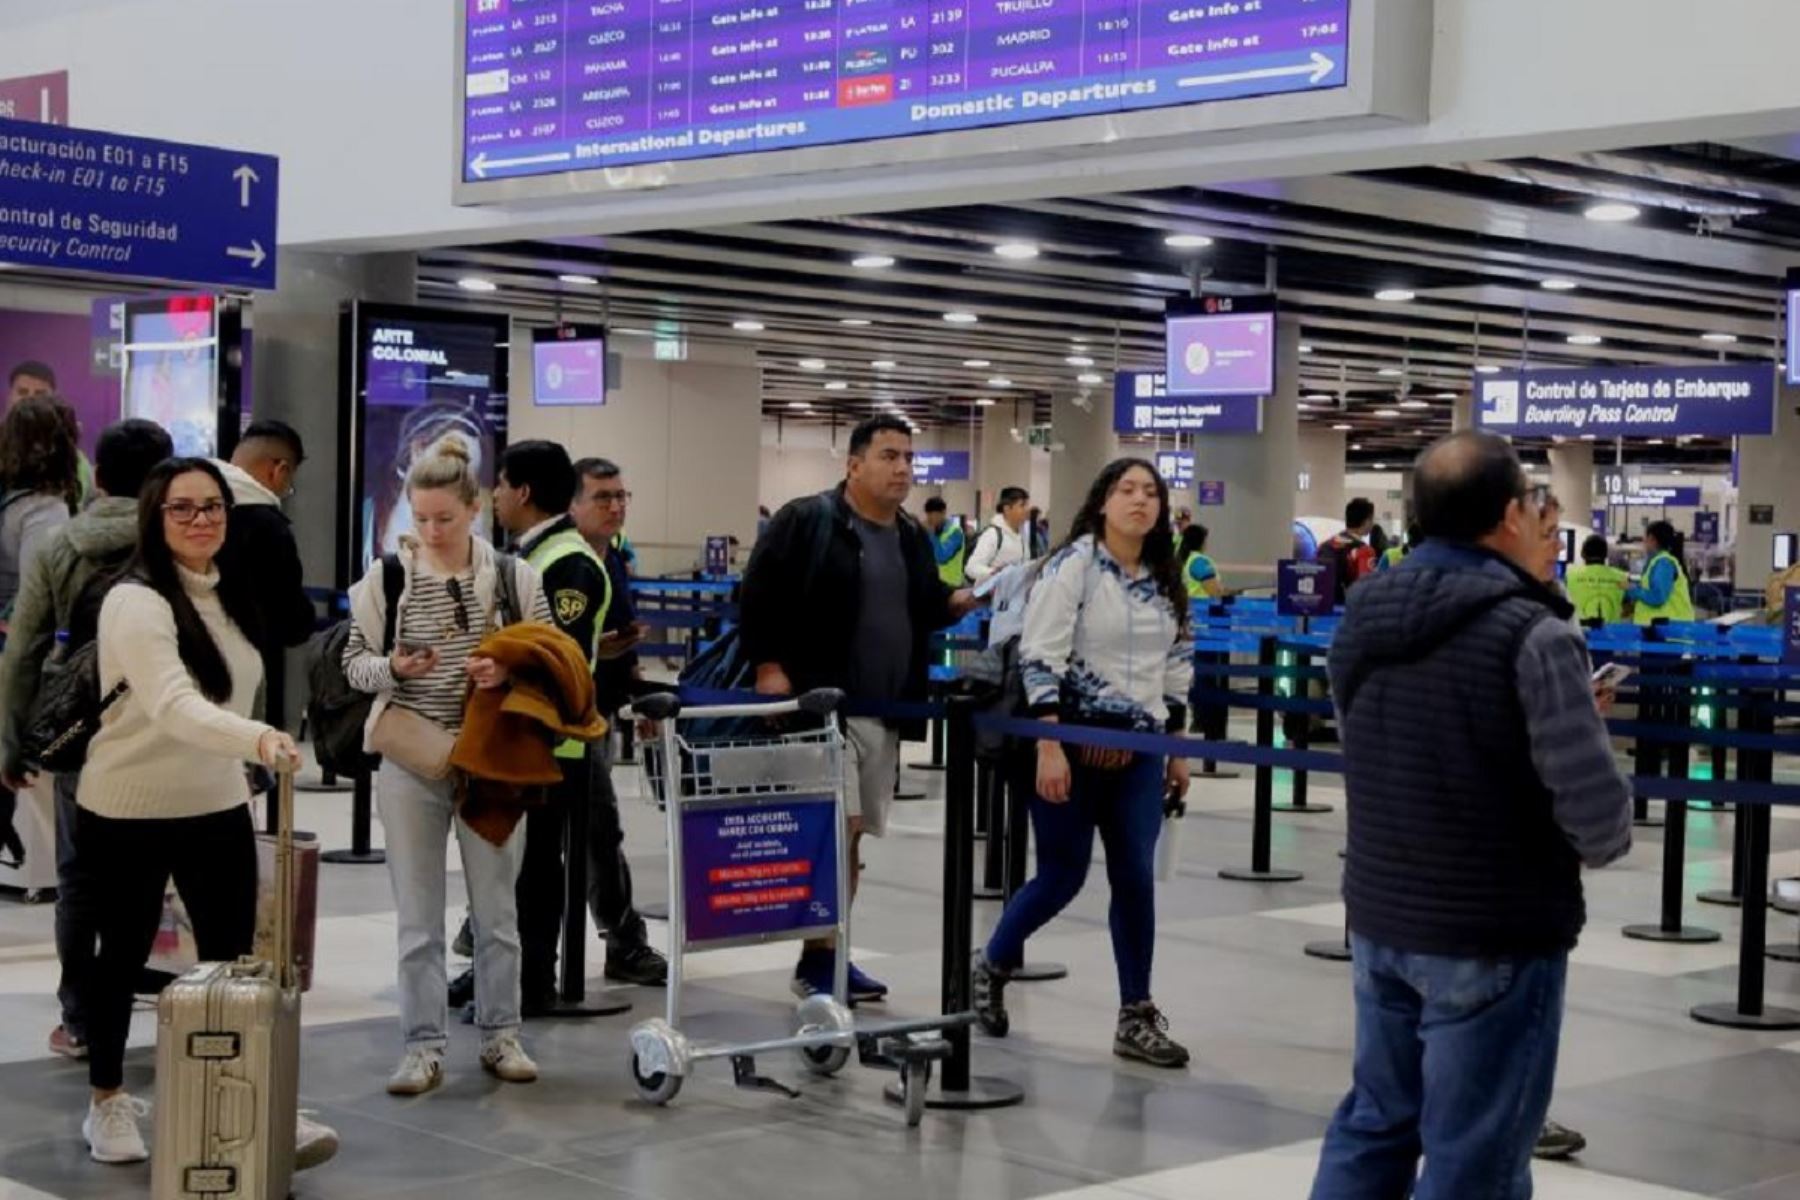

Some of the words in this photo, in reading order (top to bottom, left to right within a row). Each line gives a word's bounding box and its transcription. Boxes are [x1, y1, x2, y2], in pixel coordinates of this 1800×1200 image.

[995, 29, 1052, 46] MADRID
[1167, 9, 1205, 22] Gate
[1244, 0, 1262, 12] at
[989, 60, 1056, 79] PUCALLPA
[1167, 44, 1204, 56] Gate
[1243, 35, 1260, 47] at
[911, 96, 1014, 121] Domestic
[1022, 79, 1158, 109] Departures
[575, 131, 694, 159] International
[698, 119, 807, 146] Departures
[103, 144, 135, 168] E01
[142, 153, 153, 169] a
[158, 152, 190, 175] F15
[72, 166, 105, 192] E01
[110, 175, 129, 193] to
[134, 174, 166, 197] F15
[0, 207, 55, 229] ontrol
[60, 212, 83, 231] de
[88, 213, 178, 243] Seguridad
[66, 237, 132, 262] Control
[1217, 298, 1233, 311] LG
[372, 328, 414, 345] ARTE
[372, 345, 449, 366] COLONIAL
[1526, 380, 1576, 399] Control
[1579, 380, 1597, 399] de
[1600, 379, 1650, 402] Tarjeta
[1652, 379, 1671, 399] de
[1674, 378, 1751, 401] Embarque
[1525, 403, 1586, 428] Boarding
[1588, 404, 1622, 423] Pass
[1625, 403, 1679, 423] Control
[1603, 474, 1622, 494] 10
[560, 597, 583, 617] SP
